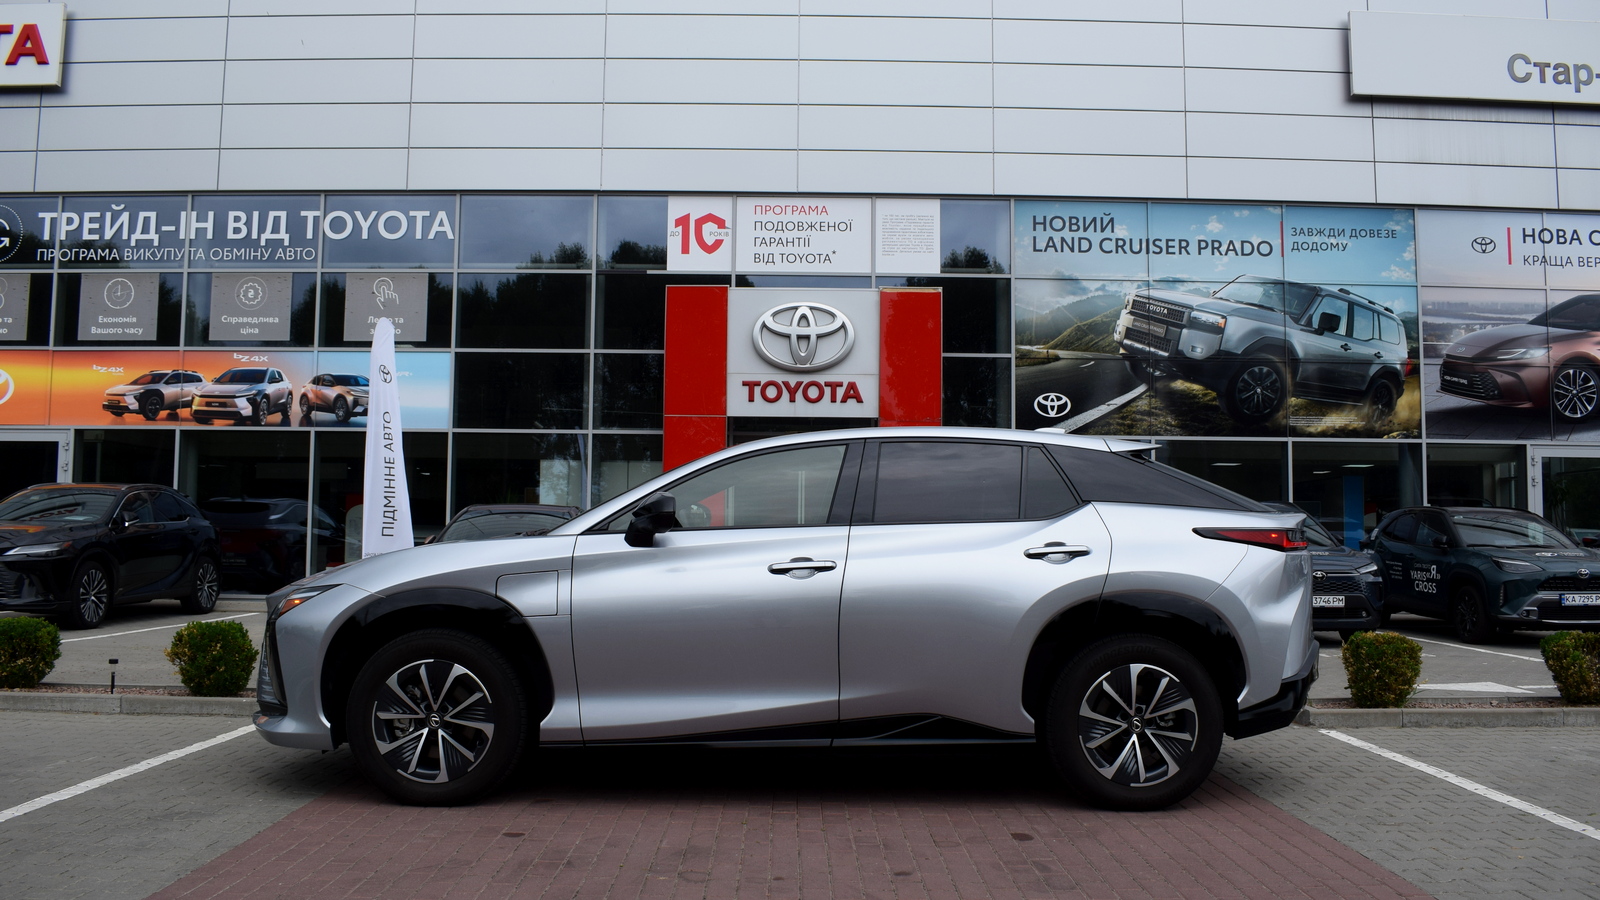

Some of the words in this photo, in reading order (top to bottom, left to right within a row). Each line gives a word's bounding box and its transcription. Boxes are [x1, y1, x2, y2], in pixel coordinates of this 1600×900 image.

[754, 205, 829, 215] ПРОГРАМА
[38, 204, 214, 246] ТРЕЙД-ІН
[227, 211, 290, 246] ВІД
[300, 210, 454, 240] TOYOTA
[754, 219, 854, 233] ПОДОВЖЕНОЇ
[1032, 213, 1115, 233] НОВИЙ
[1290, 227, 1346, 239] ЗАВЖДИ
[1349, 229, 1397, 240] ДОВЕЗЕ
[1522, 227, 1583, 245] НОВА
[1588, 229, 1600, 246] C
[753, 235, 812, 247] ГАРАНТІЇ
[1032, 236, 1093, 253] LAND
[1099, 237, 1190, 256] CRUISER
[1197, 239, 1273, 257] PRADO
[1291, 242, 1348, 253] ДОДОМУ
[37, 249, 119, 261] ПРОГРАМА
[125, 248, 184, 261] ВИКУПУ
[188, 248, 206, 260] ТА
[210, 247, 272, 261] ОБМІНУ
[275, 247, 316, 260] АВТО
[753, 253, 775, 265] ВІД
[1523, 255, 1574, 269] КРАЩА
[1577, 256, 1600, 268] ВЕР
[1146, 304, 1167, 314] TOYOTA
[98, 315, 137, 323] Економія
[221, 315, 279, 324] Справедлива
[91, 326, 123, 334] Вашого
[124, 327, 144, 336] часу
[240, 326, 259, 335] ціна
[742, 380, 864, 403] TOYOTA
[382, 411, 395, 453] АВТО
[381, 456, 398, 537] ПІДМІННЕ
[1410, 570, 1426, 580] YARIS
[1414, 581, 1436, 593] CROSS
[1565, 595, 1576, 603] KA
[1578, 595, 1594, 603] 7295
